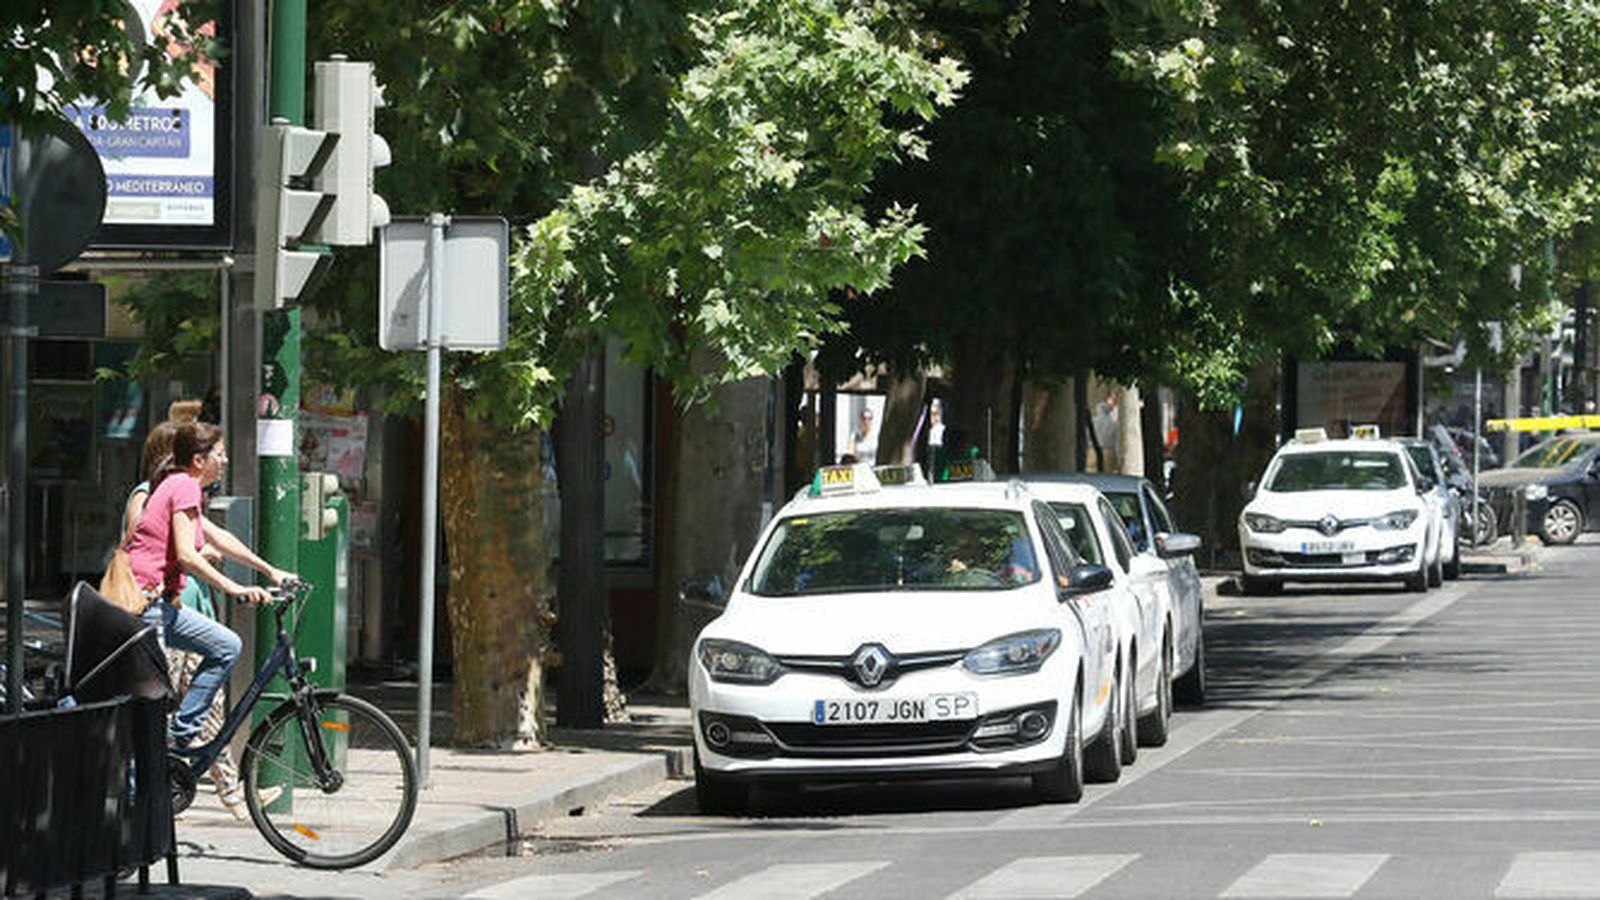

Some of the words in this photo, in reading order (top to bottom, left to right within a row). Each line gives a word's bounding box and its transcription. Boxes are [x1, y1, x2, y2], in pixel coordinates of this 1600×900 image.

[823, 470, 853, 482] TAXI
[828, 702, 879, 720] 2107
[887, 701, 925, 719] JGN
[935, 697, 970, 717] SP
